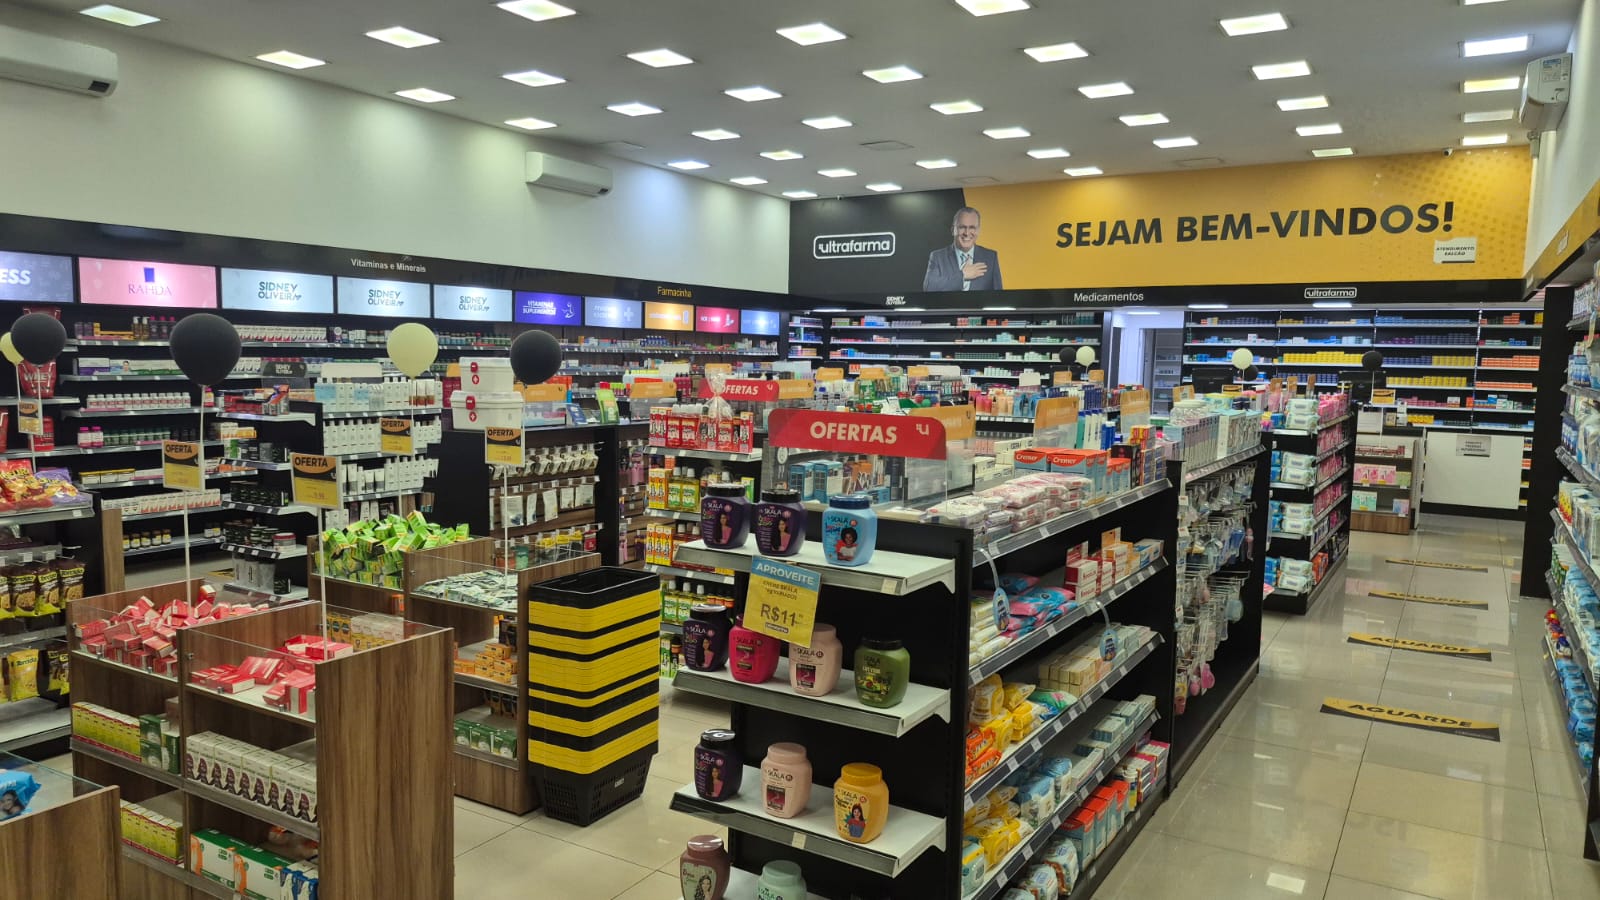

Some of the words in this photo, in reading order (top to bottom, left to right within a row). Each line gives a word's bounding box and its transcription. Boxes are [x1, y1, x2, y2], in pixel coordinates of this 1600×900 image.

[1056, 217, 1163, 249] SEJAM
[1176, 201, 1455, 243] BEM-VINDOS!
[817, 236, 892, 256] ultrafarma
[350, 257, 389, 270] Vitaminas
[127, 283, 173, 297] RAHDA
[258, 280, 298, 294] SIDNEY
[657, 286, 693, 298] Farmacinha
[1306, 287, 1357, 298] ultrafarma
[368, 289, 401, 299] SIDNEY
[1073, 291, 1144, 302] Medicamentos
[459, 295, 488, 305] SIDNEY
[381, 420, 406, 428] OFERTA
[487, 429, 515, 437] OFERTA
[809, 421, 898, 445] OFERTAS
[165, 444, 193, 454] OFERTA
[294, 456, 328, 467] OFERTA
[1016, 454, 1038, 462] Cremer
[1052, 456, 1077, 465] Cremer
[755, 563, 815, 586] APROVEITE
[690, 626, 706, 634] SKALA
[1369, 636, 1472, 654] AGUARDE
[1349, 704, 1473, 728] AGUARDE
[767, 769, 785, 780] SKALA
